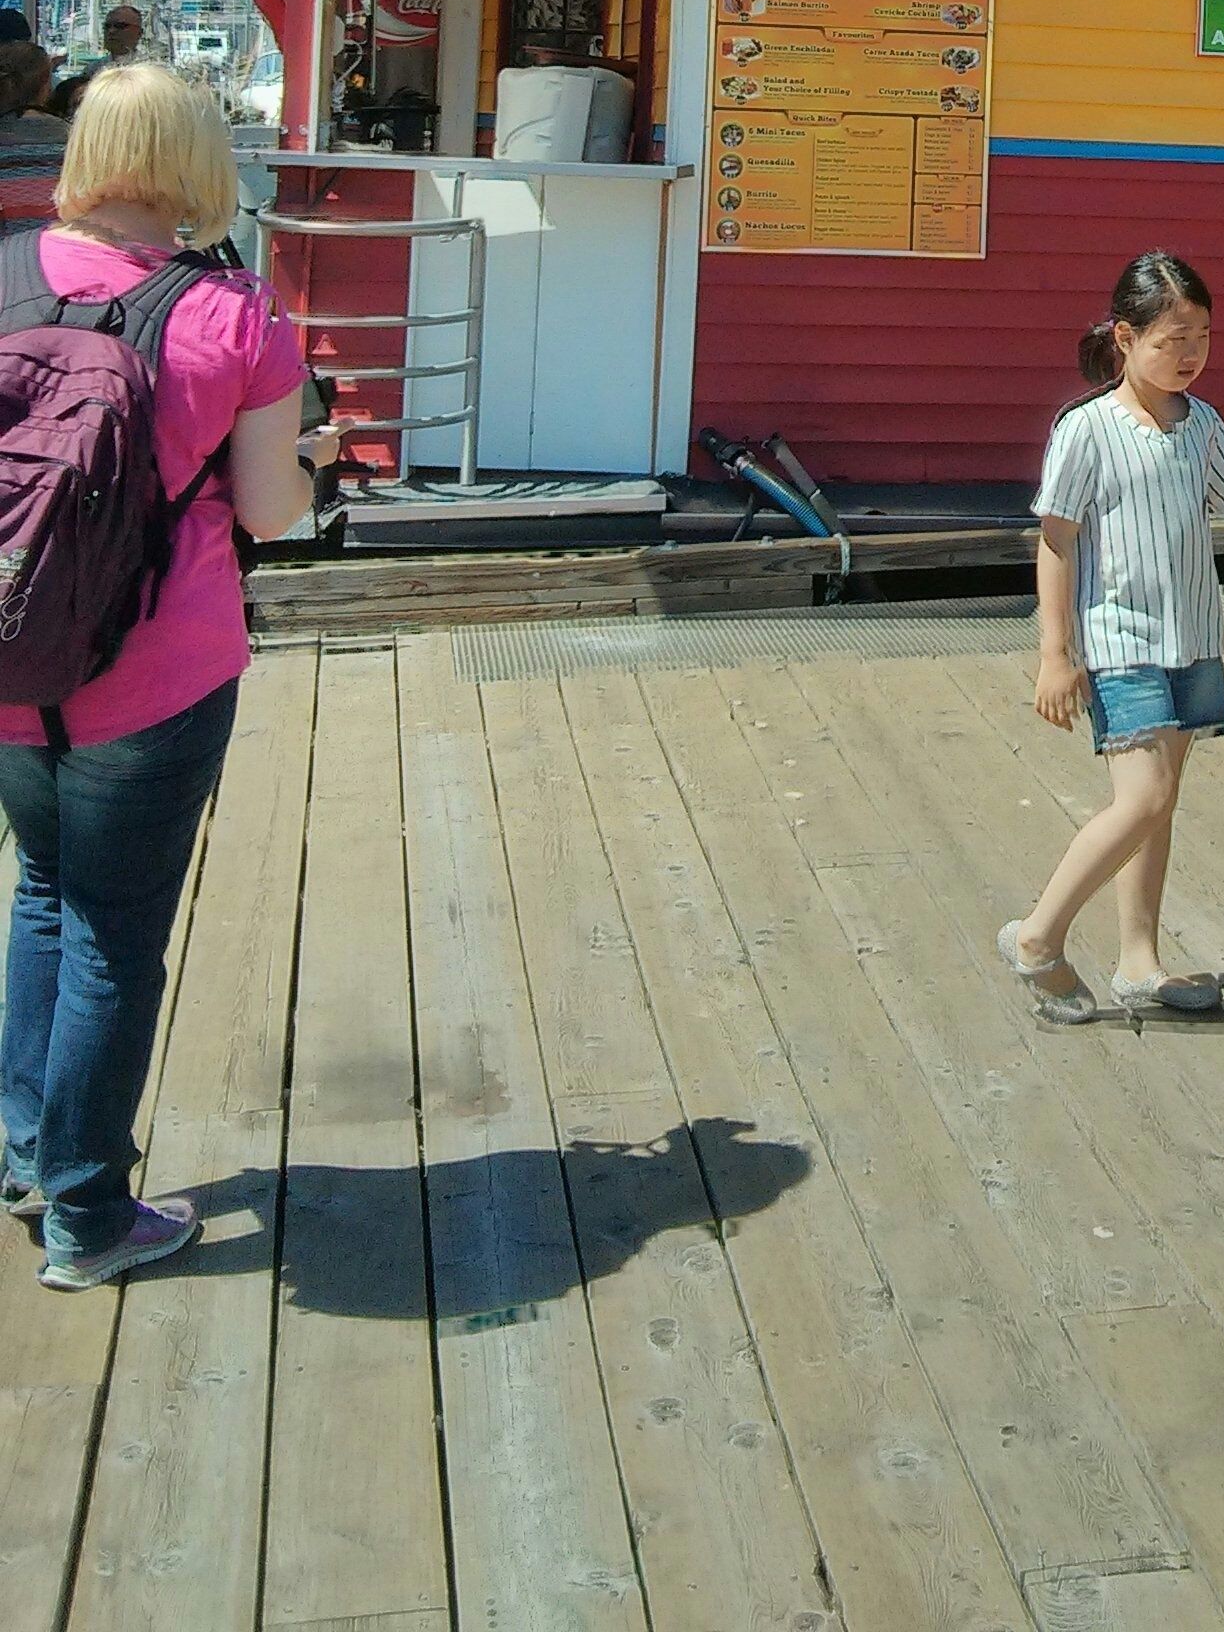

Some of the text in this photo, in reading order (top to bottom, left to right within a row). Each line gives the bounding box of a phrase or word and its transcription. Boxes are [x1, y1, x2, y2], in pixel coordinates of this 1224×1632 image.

[878, 88, 905, 97] Crispy
[756, 128, 777, 136] Mini
[747, 158, 795, 166] Quesadilla
[745, 221, 779, 230] Nachos
